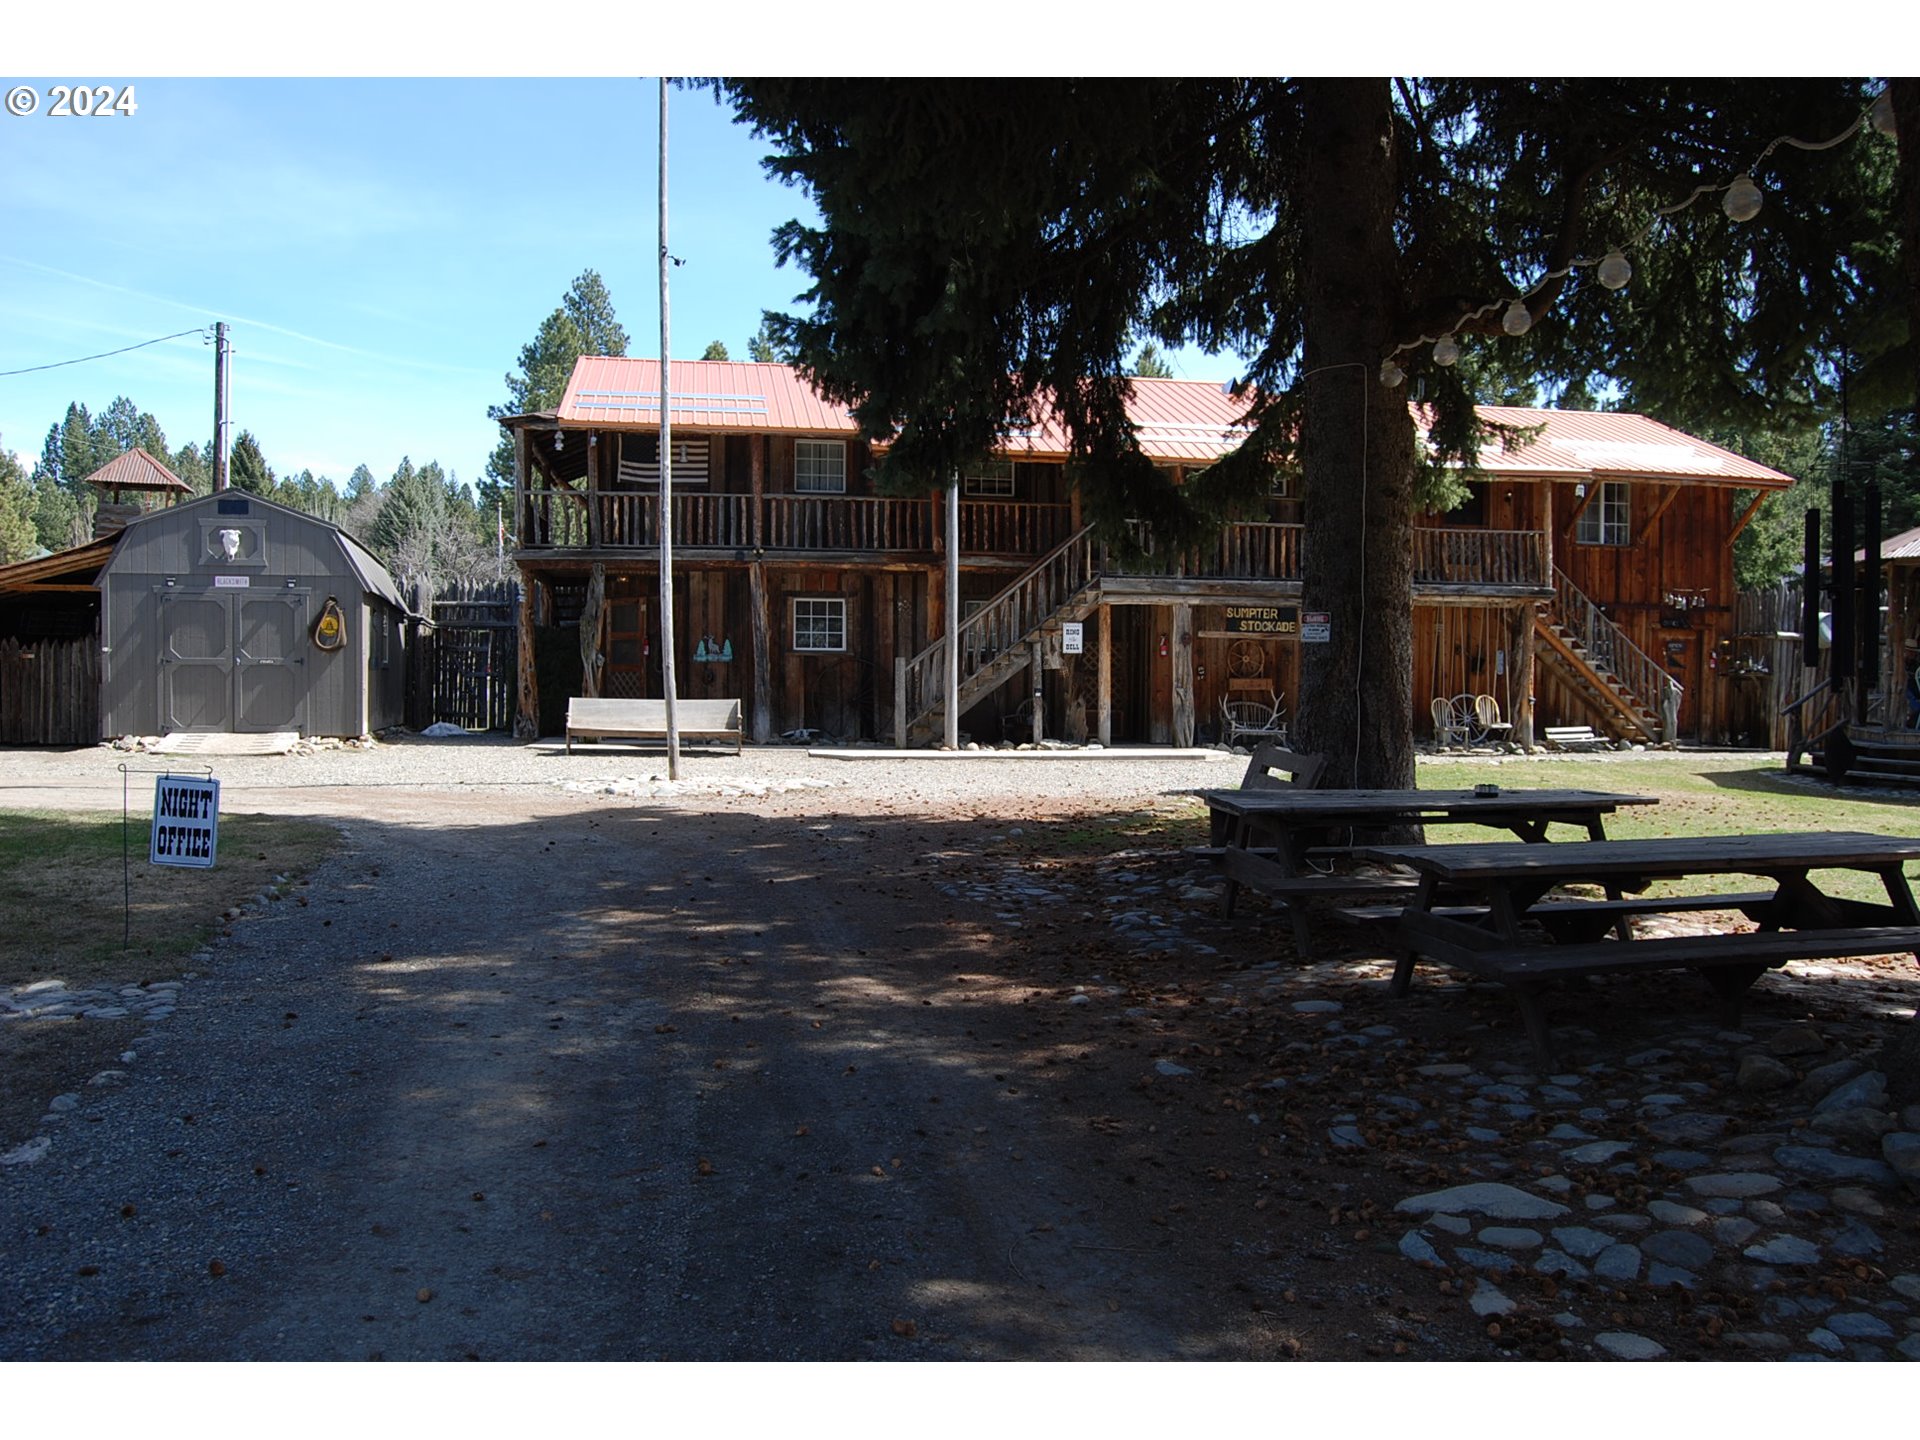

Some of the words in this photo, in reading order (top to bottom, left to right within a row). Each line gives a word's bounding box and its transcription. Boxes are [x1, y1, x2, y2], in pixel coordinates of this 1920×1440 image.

[1226, 607, 1278, 619] SUMPTER
[1240, 620, 1296, 632] STOCKADE
[160, 787, 213, 819] NIGHT
[157, 825, 211, 858] OFFICE
